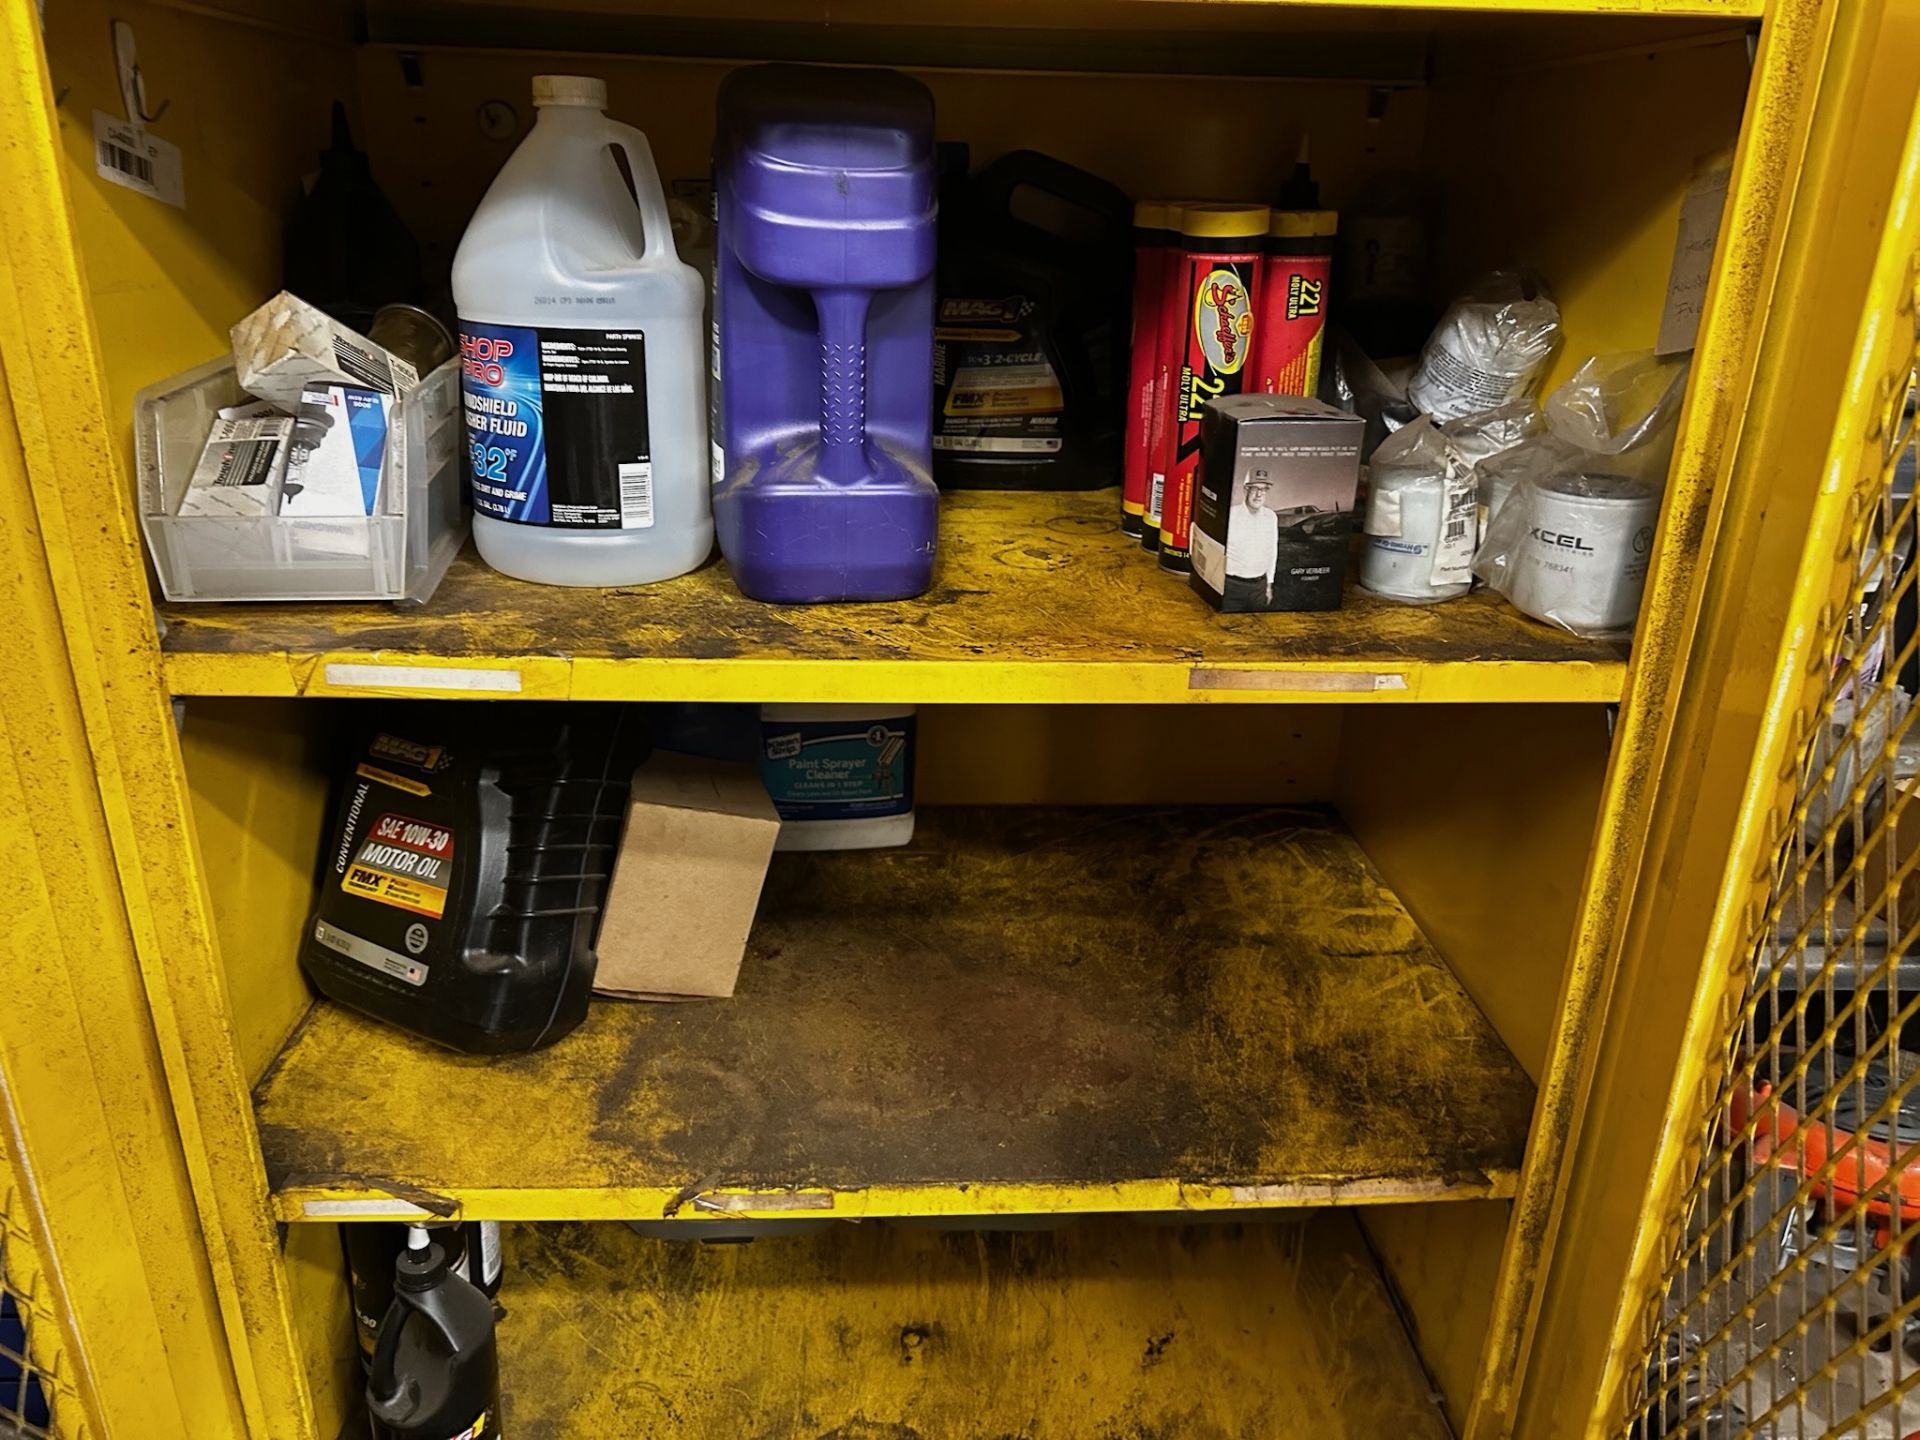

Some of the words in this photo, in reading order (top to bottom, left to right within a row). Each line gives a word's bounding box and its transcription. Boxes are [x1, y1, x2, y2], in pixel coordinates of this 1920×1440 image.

[1290, 276, 1301, 295] MOLY
[1300, 280, 1322, 317] 221
[1287, 294, 1300, 320] ULTRA
[1210, 282, 1244, 364] Schaeffer's
[934, 342, 946, 386] MARINE
[994, 352, 1042, 364] 2-CYCLE
[462, 357, 504, 387] PRO
[1180, 366, 1192, 393] MOLY
[463, 390, 518, 417] DSHIELD
[1177, 393, 1190, 422] ULTRA
[489, 417, 528, 437] FLUID
[491, 486, 504, 497] AND
[788, 758, 819, 769] Paint
[820, 757, 867, 771] Sprayer
[805, 769, 850, 780] Cleaner
[335, 783, 370, 874] CONVENTIONAL
[376, 816, 403, 841] SAE
[400, 821, 450, 852] 10W-30
[360, 842, 416, 873] MOTOR
[416, 857, 442, 880] OIL
[349, 868, 384, 888] FMX
